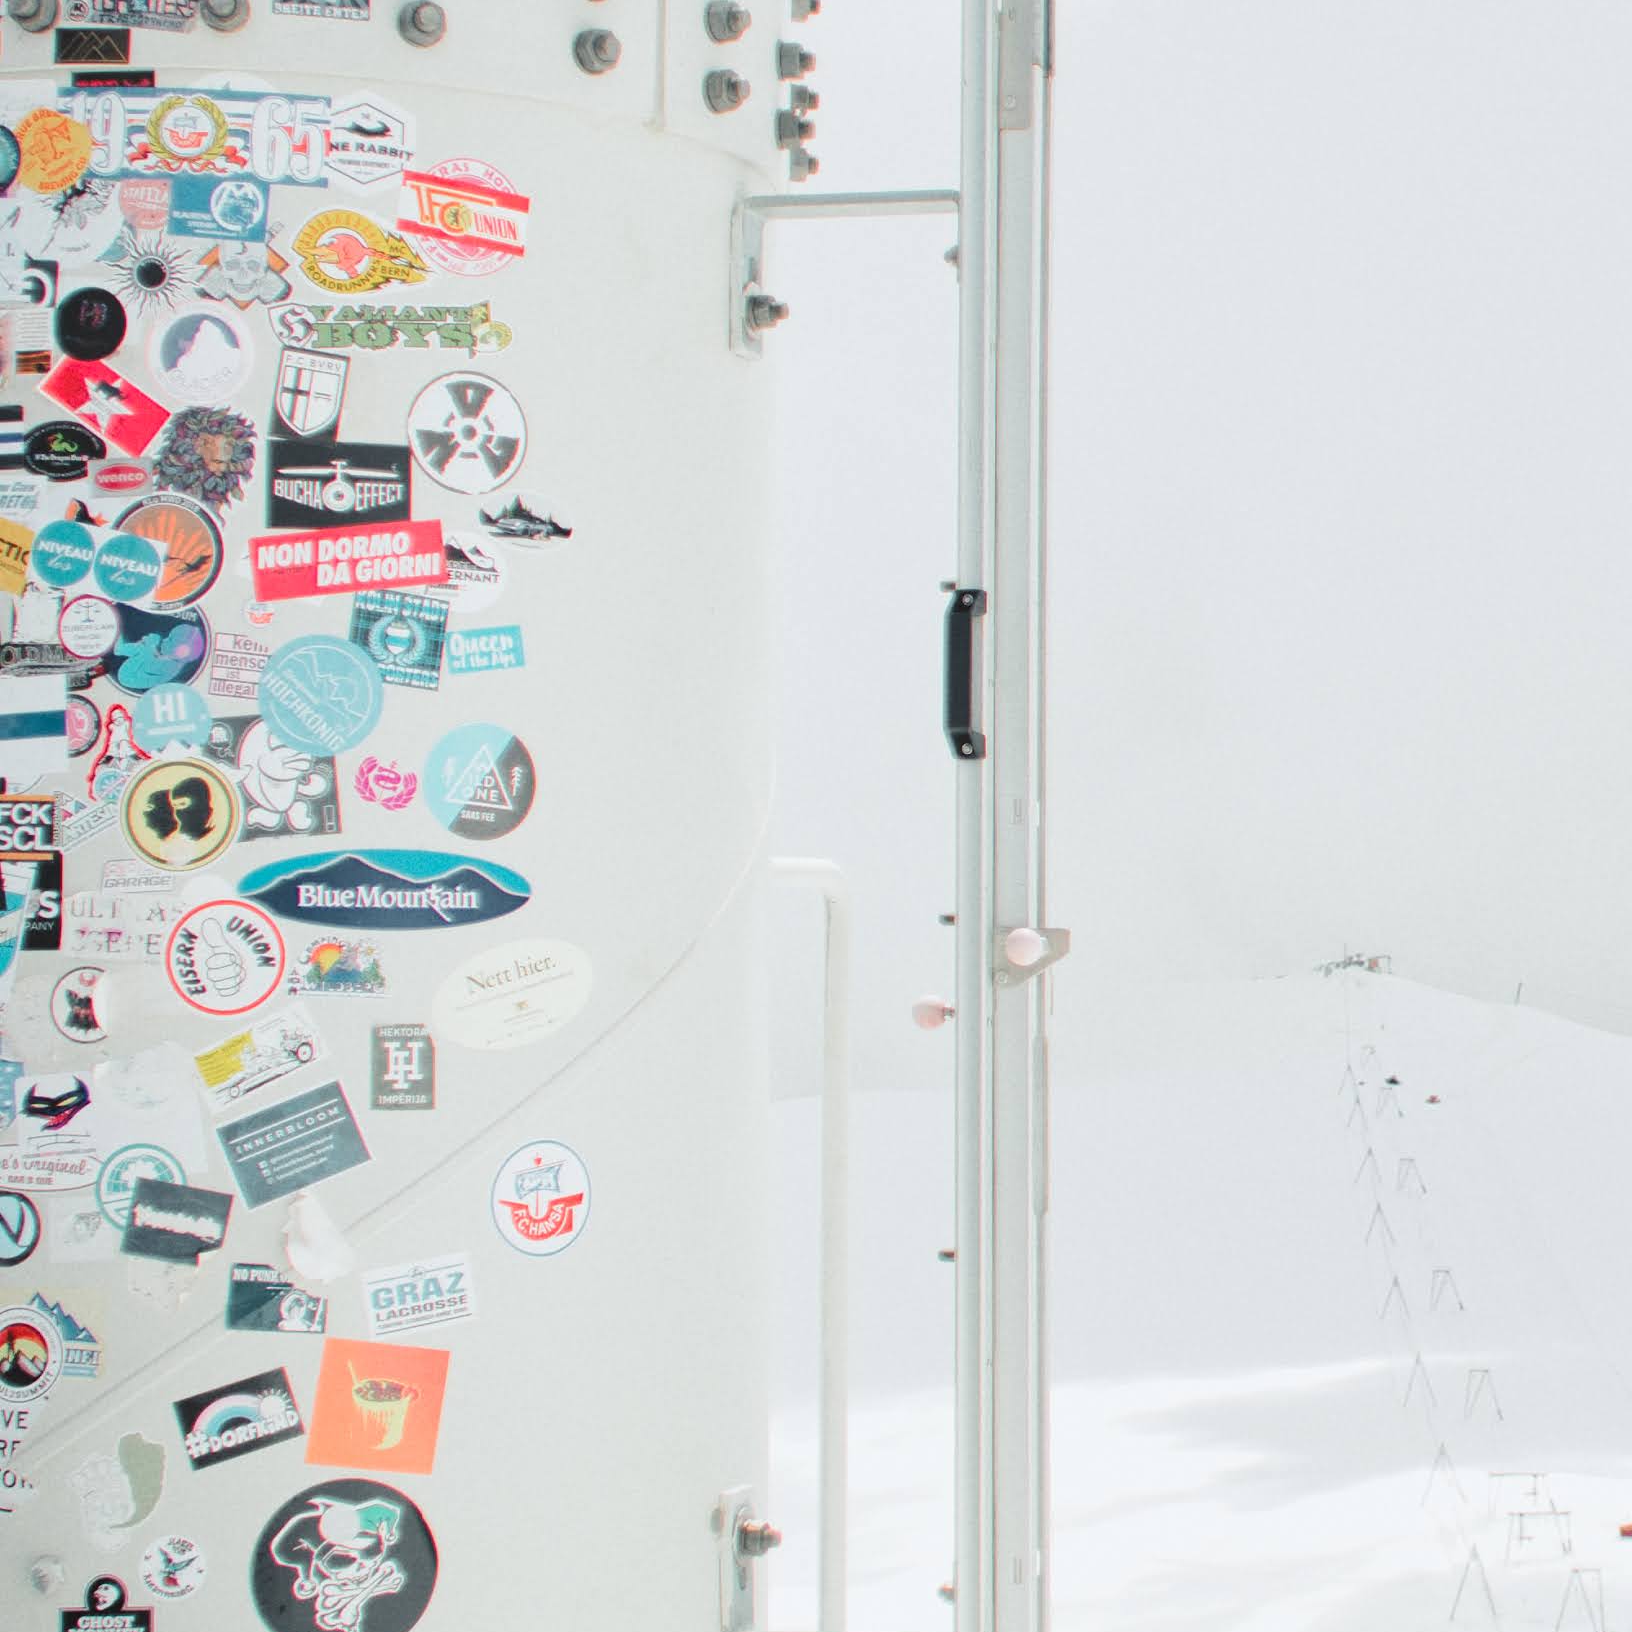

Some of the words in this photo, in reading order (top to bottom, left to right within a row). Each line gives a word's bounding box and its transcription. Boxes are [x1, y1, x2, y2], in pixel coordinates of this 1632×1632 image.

[355, 142, 414, 162] RABBIT
[473, 212, 518, 241] UNION
[380, 265, 411, 278] BERN
[311, 322, 475, 352] BOYS
[97, 469, 145, 485] wenco
[273, 478, 323, 511] BUCHA
[354, 484, 404, 512] EFFECT
[39, 540, 93, 561] NIVEAU
[257, 543, 314, 569] NON
[317, 532, 410, 564] DORMO
[102, 554, 158, 576] NIVEAU
[316, 562, 351, 588] DA
[355, 552, 441, 584] GIORNI
[447, 570, 501, 584] ERNANT
[215, 653, 266, 671] mensc
[211, 679, 256, 697] illegal
[153, 691, 186, 723] HI
[0, 802, 52, 826] FCK
[104, 875, 172, 889] GARAGE
[175, 927, 208, 997] EISERN
[225, 915, 277, 968] UNION
[466, 970, 513, 995] Nett
[528, 1203, 565, 1236] HANSA
[370, 1271, 465, 1311] GRAZ
[375, 1294, 469, 1323] LACROSSE
[2, 1410, 30, 1429] VE
[77, 1615, 135, 1629] GHOST
